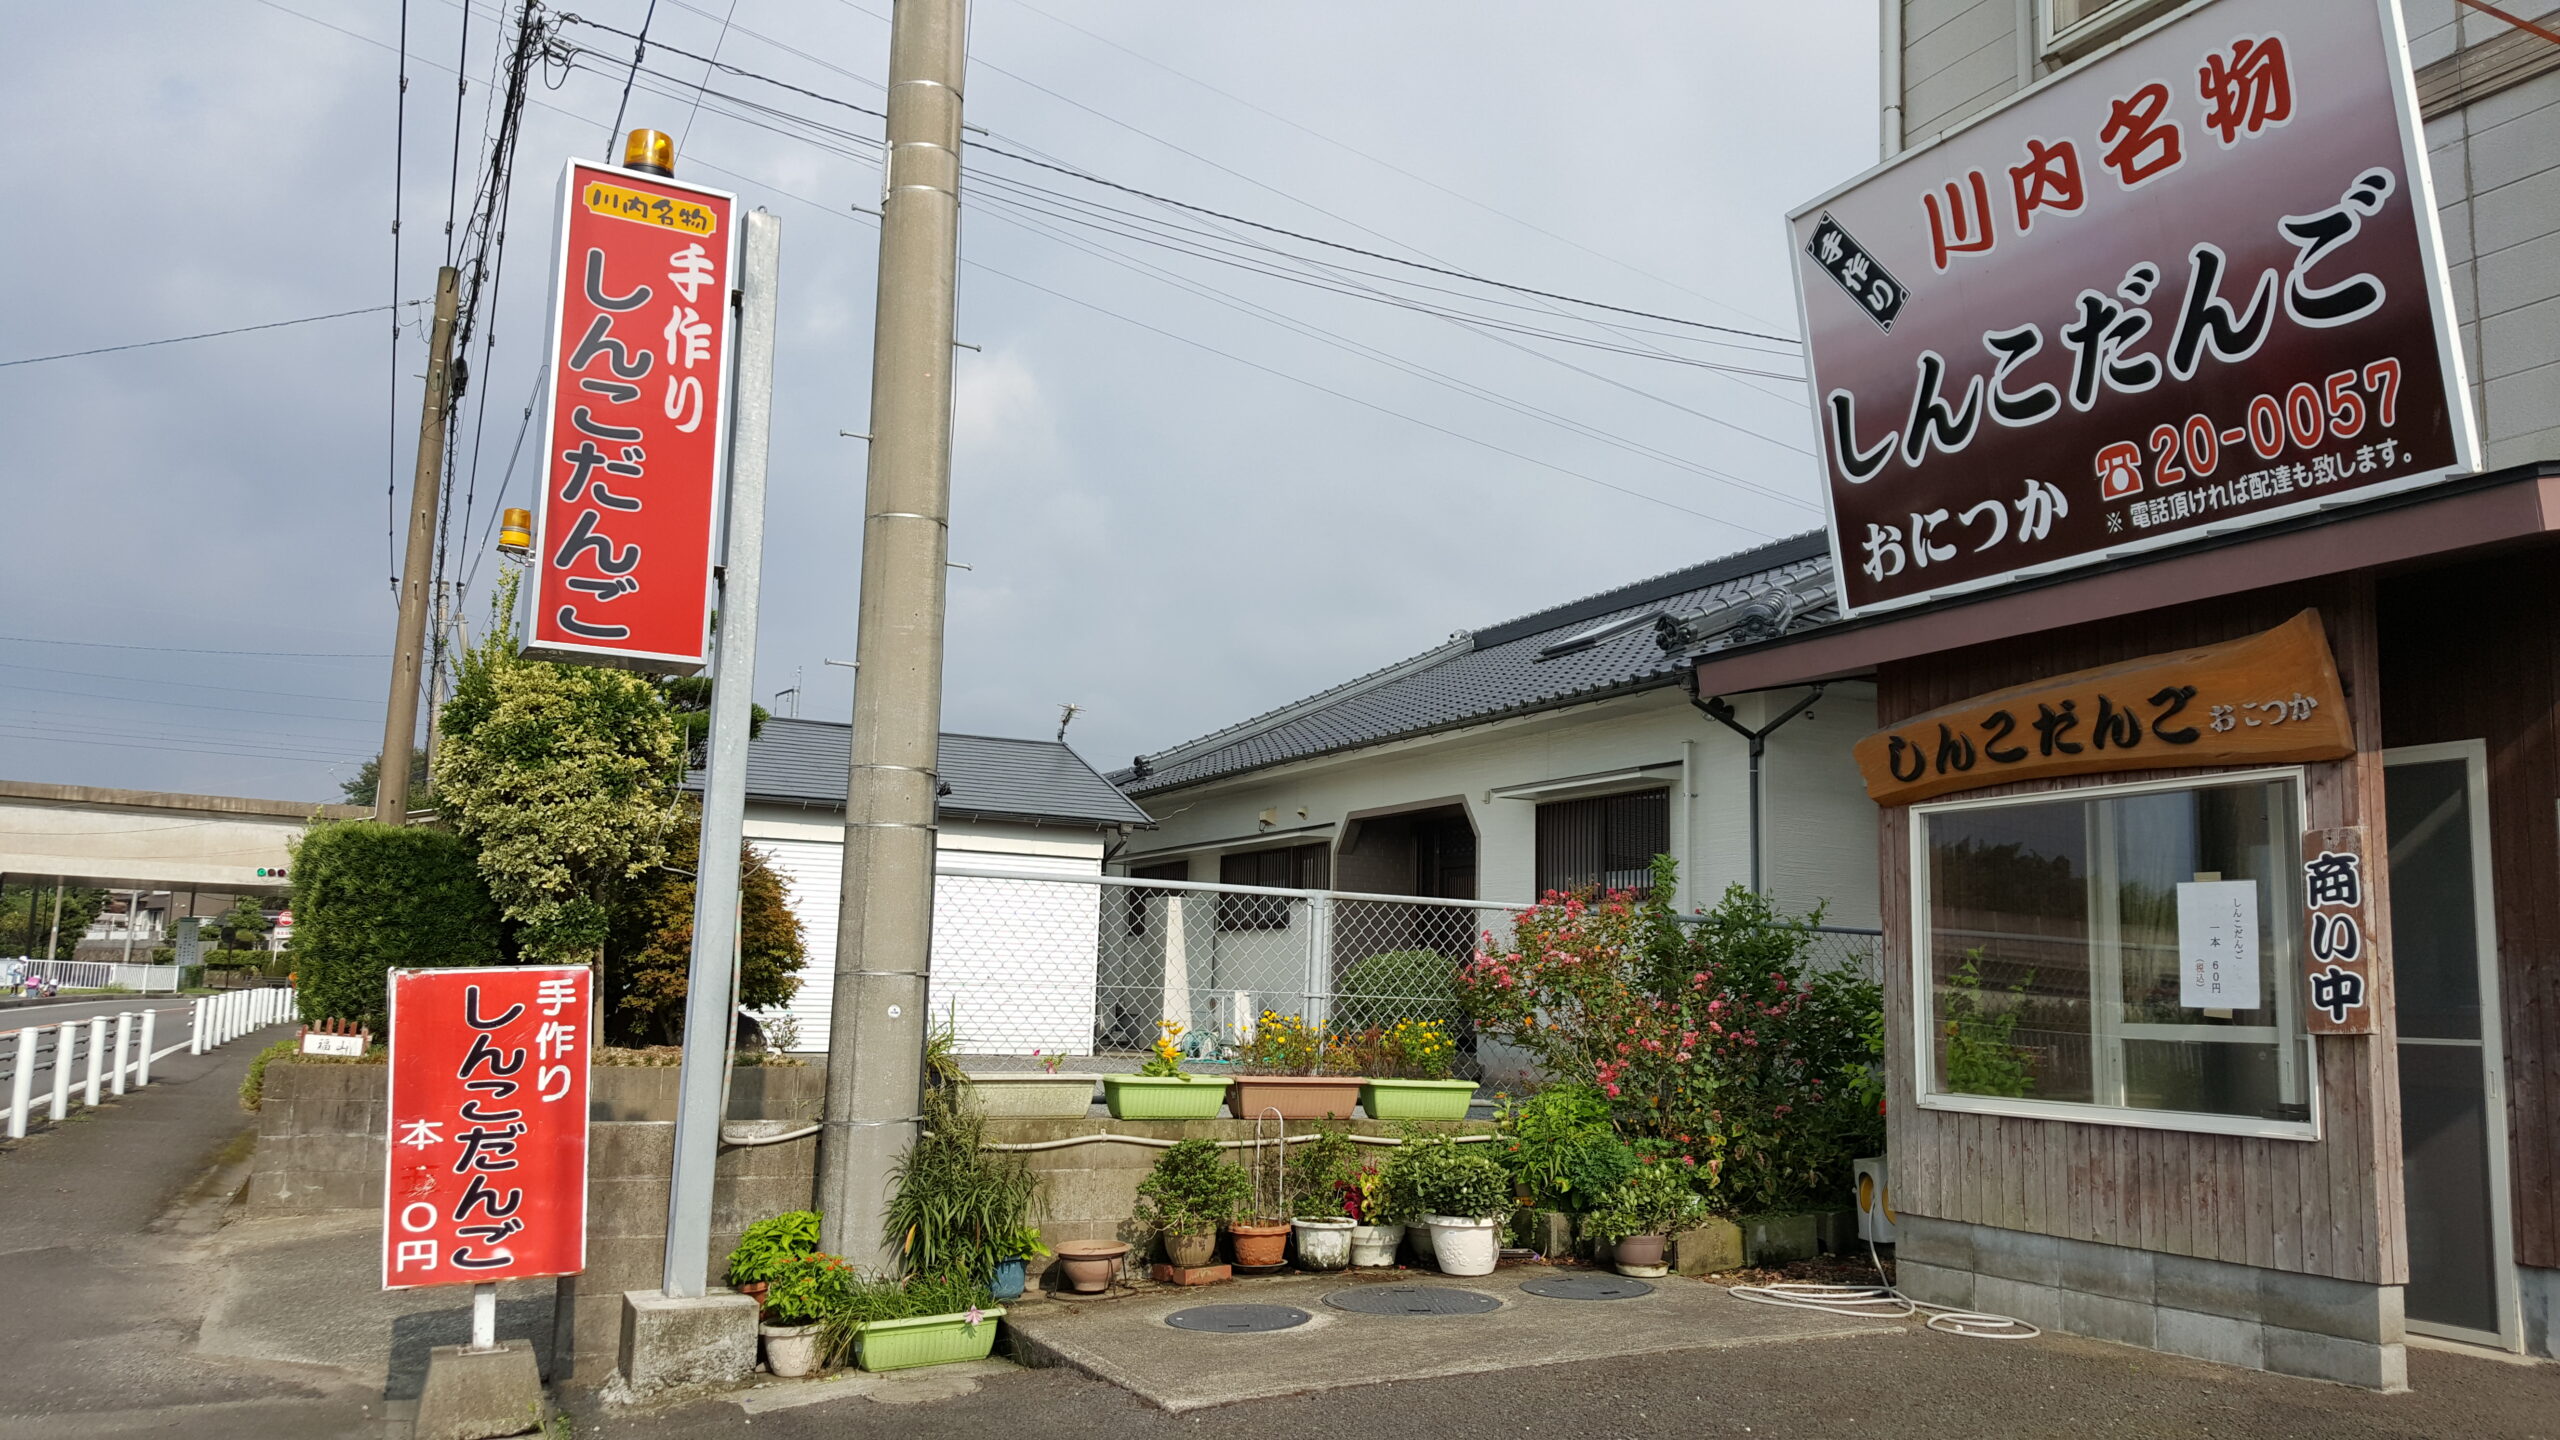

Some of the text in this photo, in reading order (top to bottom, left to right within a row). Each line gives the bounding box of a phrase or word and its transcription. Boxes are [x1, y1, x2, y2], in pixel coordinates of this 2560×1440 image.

[593, 189, 707, 230] 川内名物
[1920, 33, 2296, 272] 川内名物
[1821, 230, 1894, 311] 手作り
[1827, 167, 2395, 484] しんこだんご
[663, 243, 715, 433] 手作り
[553, 247, 654, 640] しんこだんご
[2149, 356, 2401, 487] 20-0057
[1862, 479, 2069, 582] おにつか
[1888, 685, 2200, 782] しんこだんご
[2232, 897, 2244, 960] しんこだんご
[2304, 850, 2365, 1024] 商い中
[535, 978, 577, 1103] 手作り
[452, 984, 527, 1269] しんこだんご
